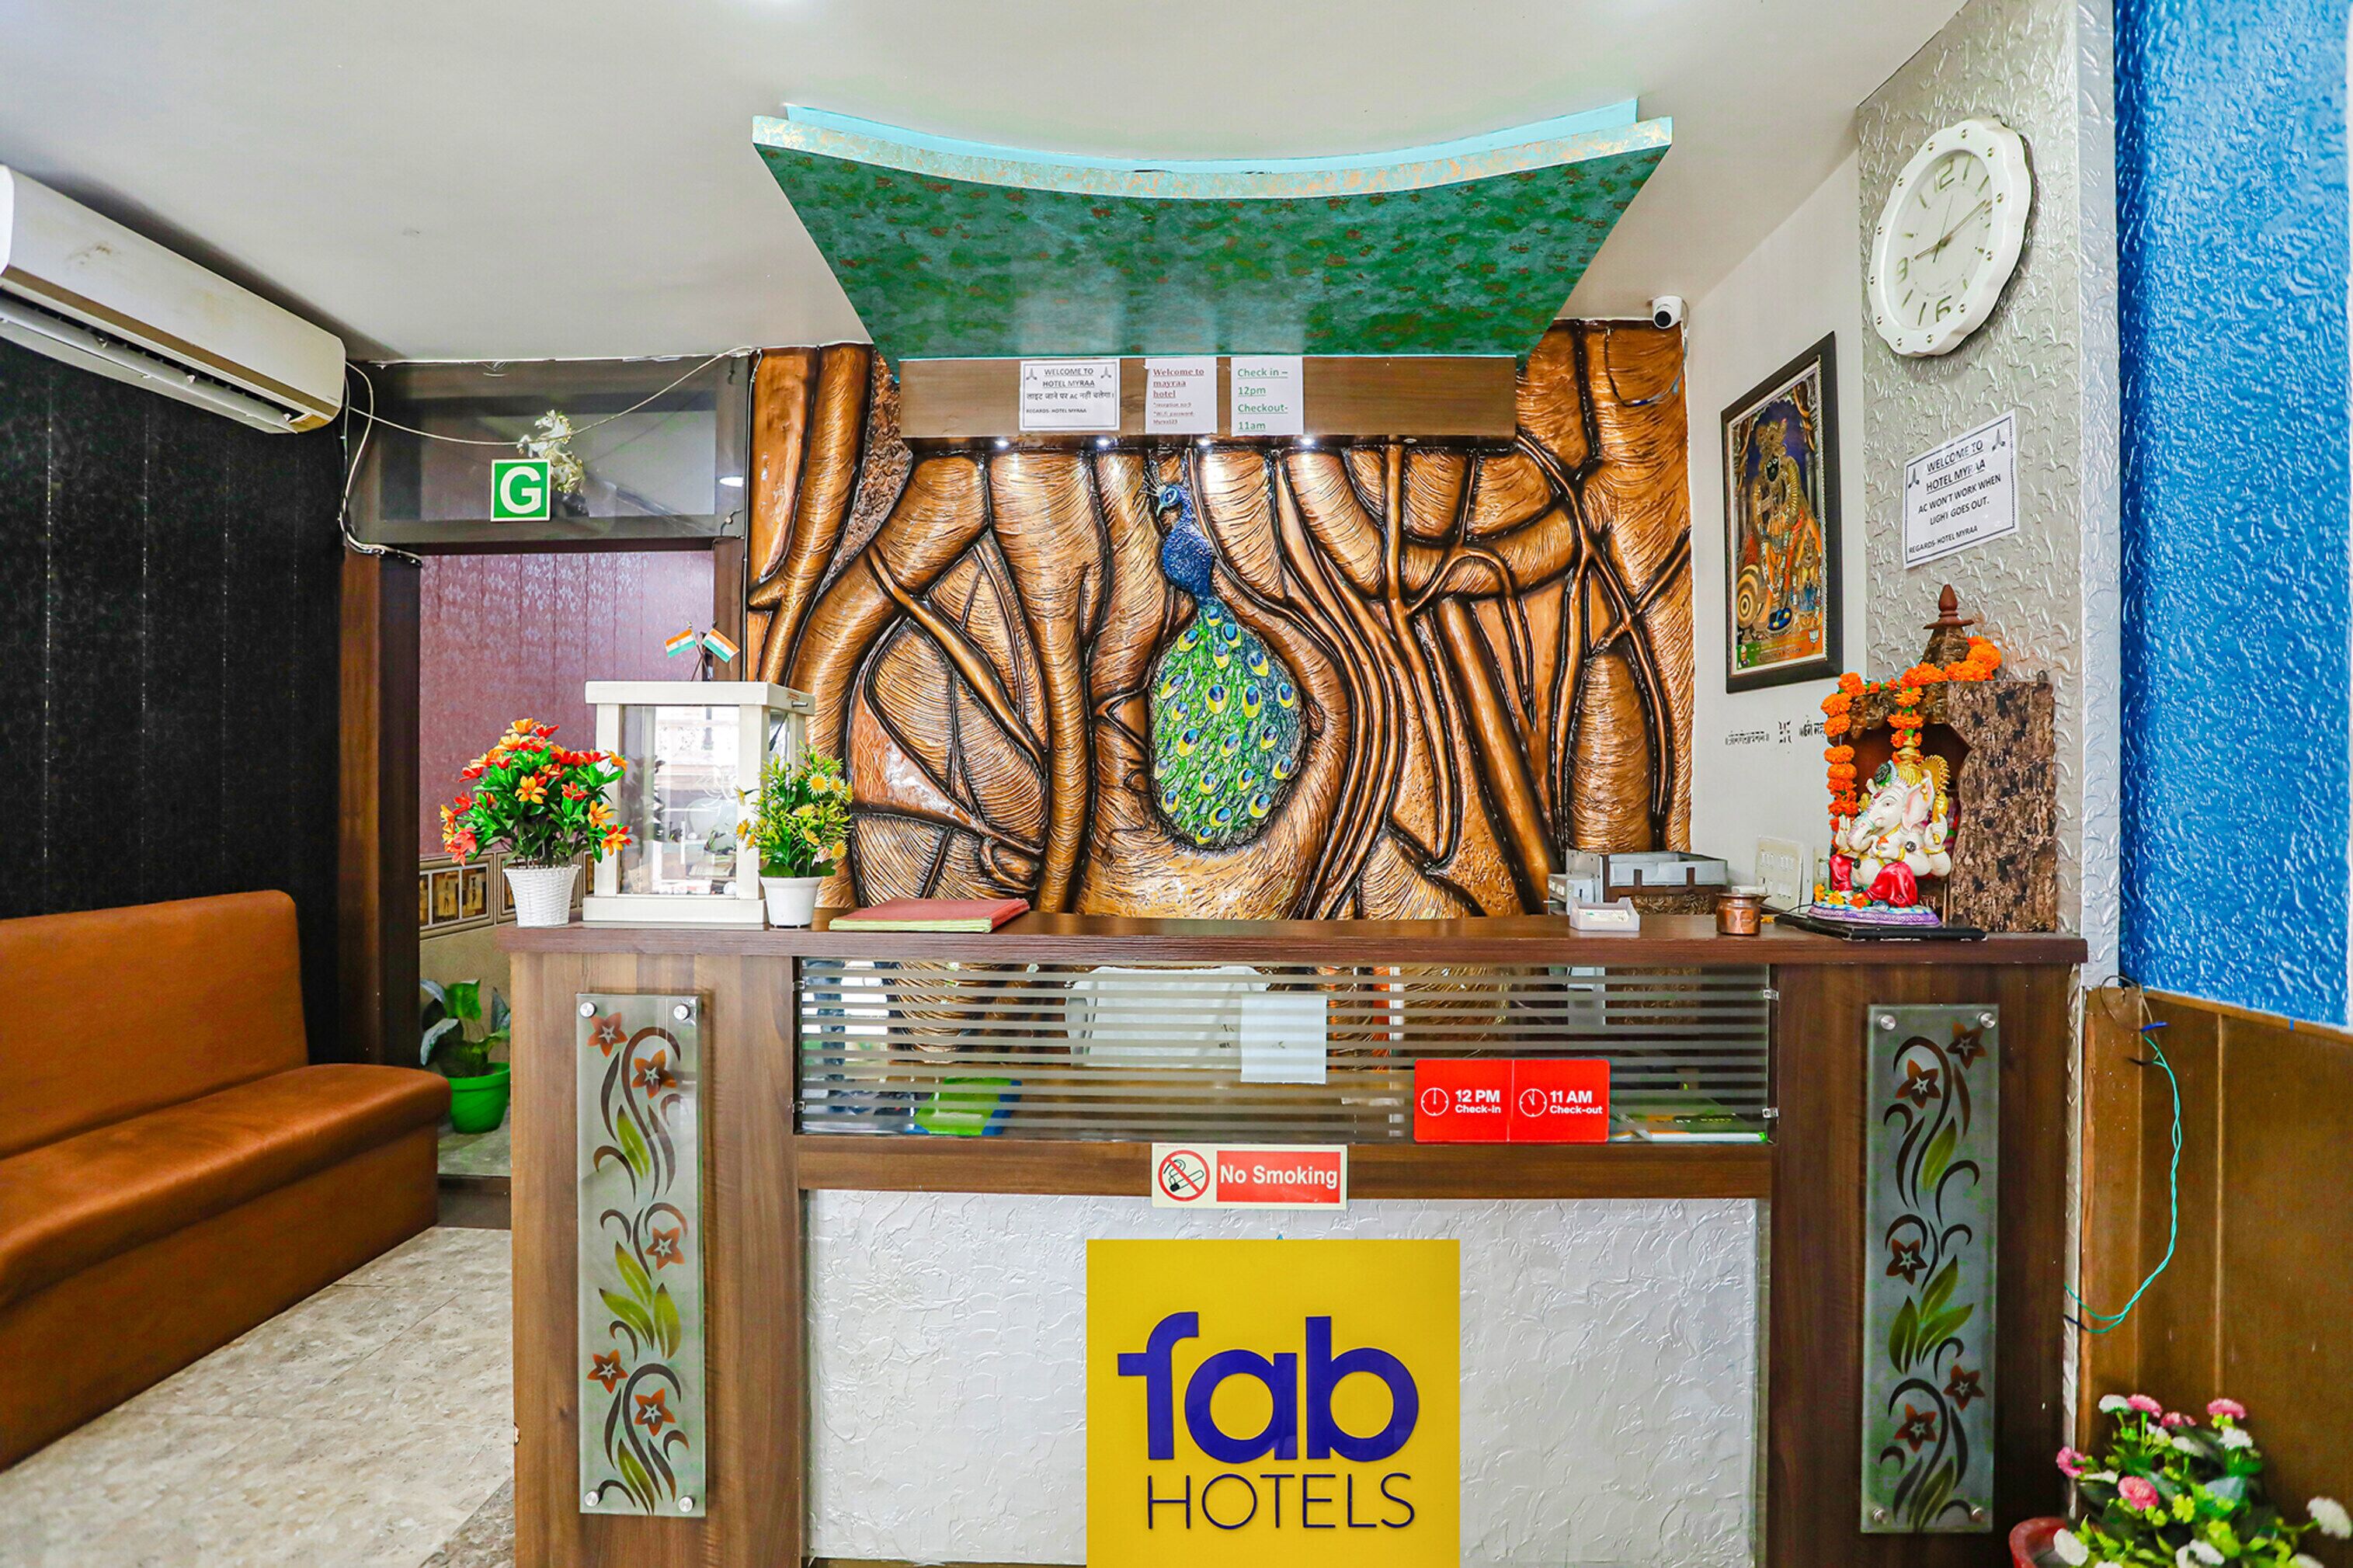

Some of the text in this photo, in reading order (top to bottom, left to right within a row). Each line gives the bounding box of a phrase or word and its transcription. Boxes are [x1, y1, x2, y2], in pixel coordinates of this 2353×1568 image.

[1237, 368, 1267, 377] Check
[1270, 367, 1279, 377] in
[1153, 390, 1176, 398] hotel
[1238, 386, 1267, 397] 12pm
[1237, 404, 1288, 412] Checkout-
[1239, 422, 1266, 430] 11am
[1927, 440, 1984, 471] WELCOME TO
[499, 465, 543, 513] G
[1926, 472, 1954, 492] HOTEL
[1918, 474, 2001, 514] AC WON'T WORK WHEN
[1951, 502, 1970, 517] GOES
[1971, 496, 1990, 510] OUT.
[1938, 534, 1955, 544] HOTEL
[1956, 525, 1978, 538] MYRAA
[1455, 1090, 1500, 1103] 12 PM
[1549, 1090, 1592, 1104] 11 AM
[1455, 1104, 1501, 1114] Check-in
[1549, 1105, 1603, 1114] Check-out
[1220, 1164, 1338, 1190] No Smoking
[1117, 1311, 1420, 1465] fab
[1147, 1472, 1416, 1531] HOTELS
